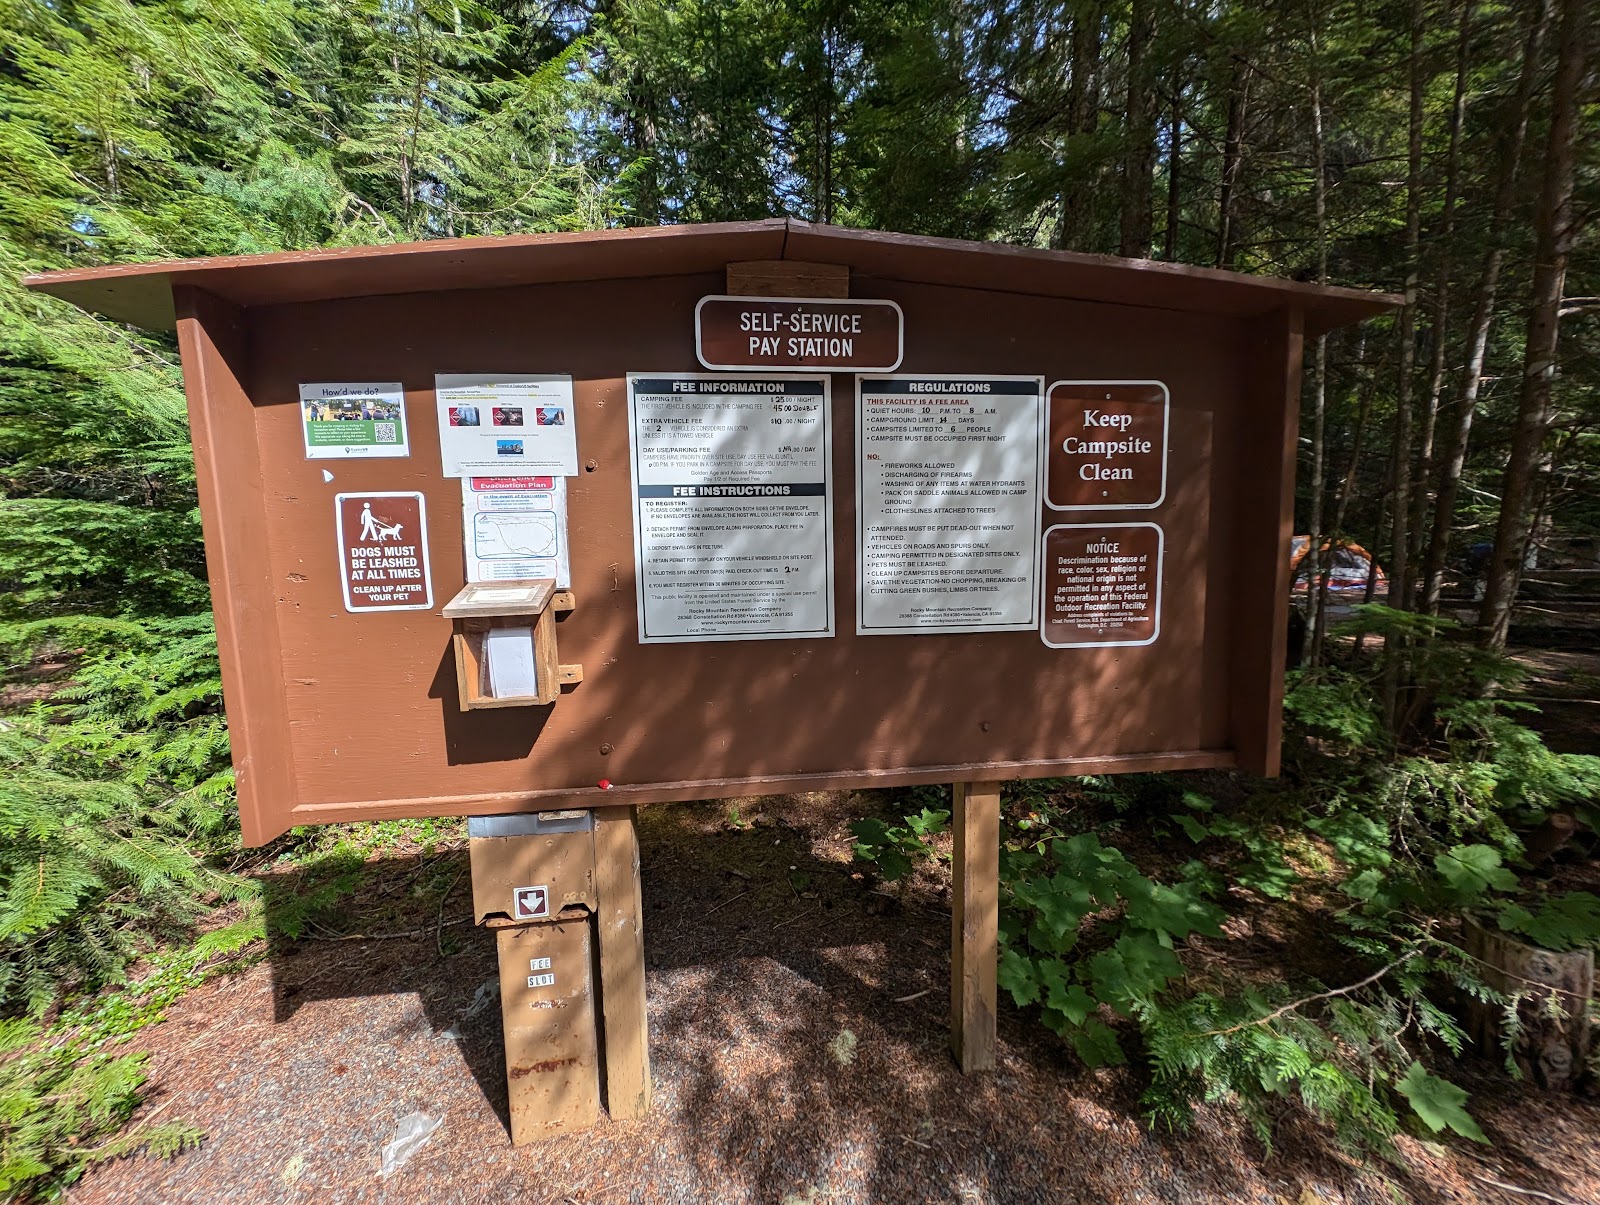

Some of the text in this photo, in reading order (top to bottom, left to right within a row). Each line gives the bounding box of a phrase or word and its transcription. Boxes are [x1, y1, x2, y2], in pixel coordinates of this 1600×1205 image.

[740, 313, 861, 333] SELF-SERVICE
[750, 338, 852, 356] PAY STATION
[322, 388, 347, 396] How'd
[673, 383, 784, 392] FEE INFORMATION
[909, 383, 991, 392] REGULATIONS
[1083, 410, 1132, 432] Keep
[1063, 437, 1151, 458] Campsite
[1079, 463, 1133, 480] Clean
[673, 486, 790, 496] FEE INSTRUCTIONS
[351, 546, 415, 557] DOGS MUST
[1087, 543, 1119, 553] NOTICE
[352, 558, 417, 568] BE LEASHED
[352, 569, 420, 580] AT ALL TIMES
[1111, 565, 1136, 574] religion
[1067, 574, 1137, 584] national origin is not
[1057, 585, 1089, 594] permitted
[1115, 583, 1137, 592] aspect
[1067, 593, 1099, 602] operation
[1124, 592, 1148, 600] Federal
[531, 959, 550, 969] FEE
[529, 975, 553, 986] SLOT
